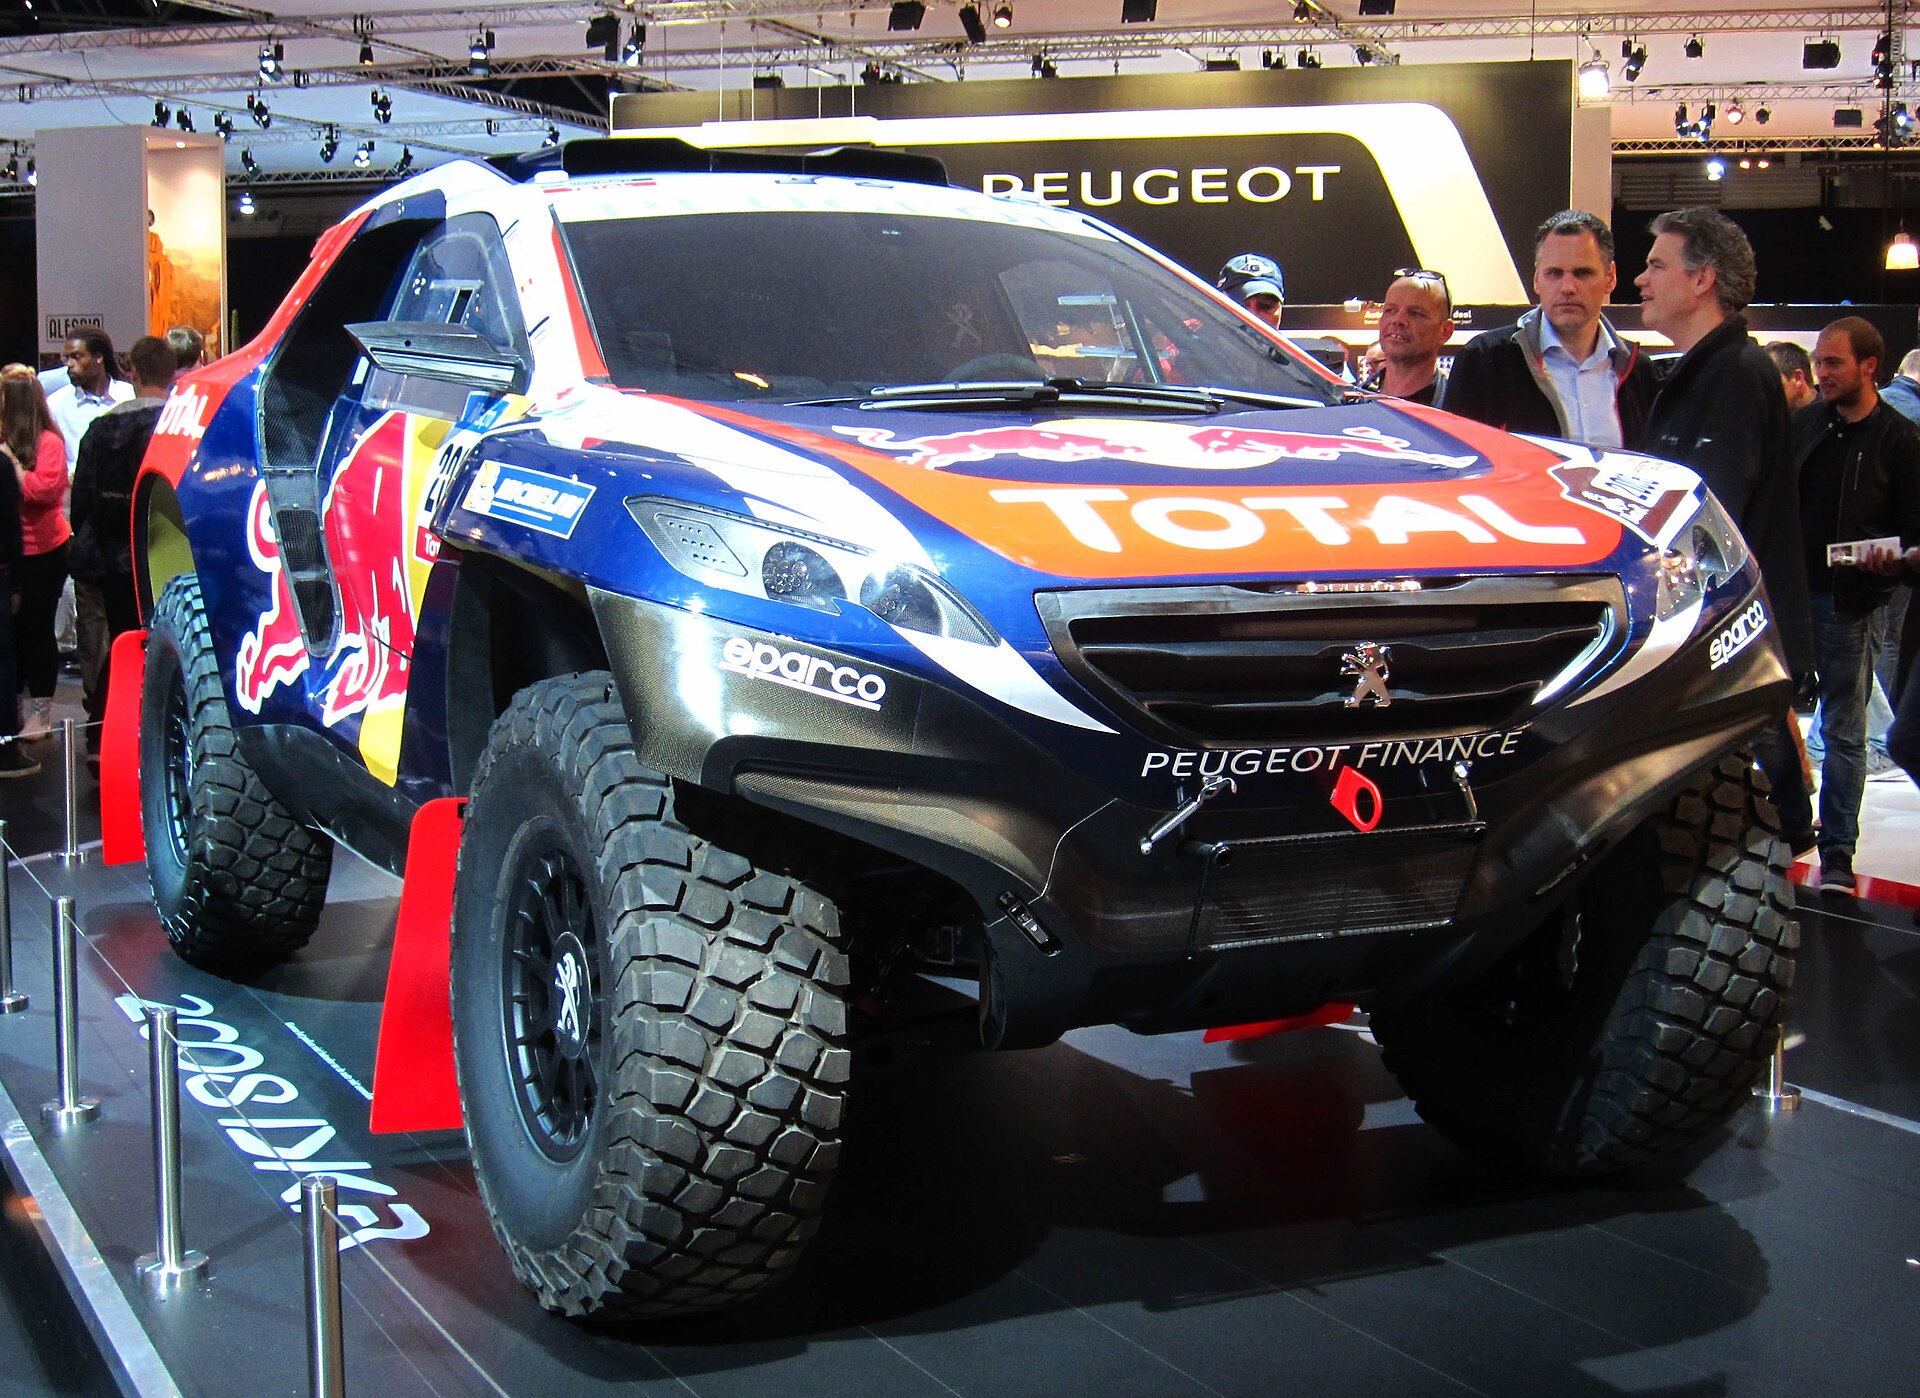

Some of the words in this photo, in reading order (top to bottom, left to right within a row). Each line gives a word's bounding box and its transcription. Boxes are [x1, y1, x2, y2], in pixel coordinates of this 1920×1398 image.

[982, 165, 1341, 207] PEUGEOT
[494, 477, 585, 519] MICHELIN
[989, 488, 1586, 553] TOTAL
[1709, 600, 1765, 664] sparco
[722, 637, 887, 703] sparco
[1140, 744, 1350, 778] PEUGEOT
[1356, 731, 1523, 768] FINANCE
